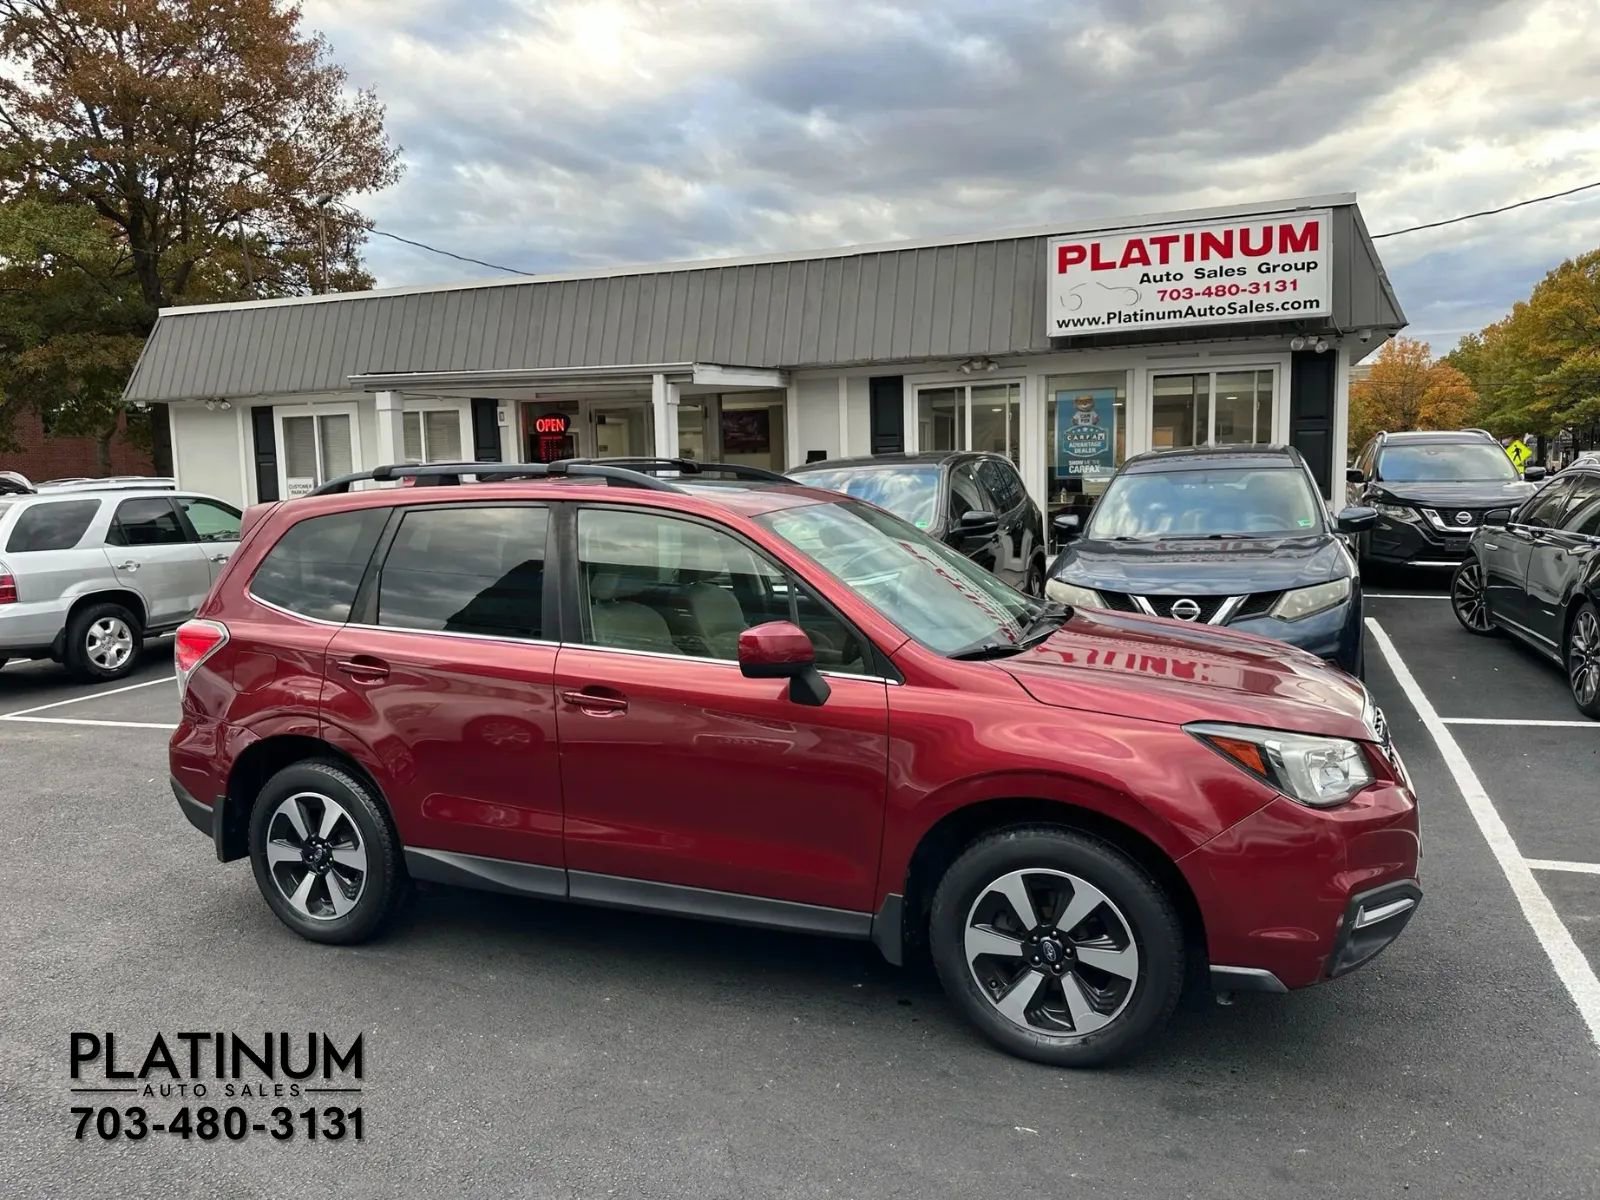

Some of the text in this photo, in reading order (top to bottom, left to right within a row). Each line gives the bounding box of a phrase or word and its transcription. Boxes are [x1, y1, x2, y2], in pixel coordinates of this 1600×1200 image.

[1057, 221, 1319, 275] PLATINUM
[1139, 259, 1318, 285] Auto Sales Group
[1157, 278, 1299, 302] 703-480-3131
[1056, 298, 1320, 329] www.PlatinumAutoSales.com
[536, 418, 565, 432] OPEN
[1067, 433, 1105, 441] CARFAX
[1068, 464, 1101, 474] CARFAX
